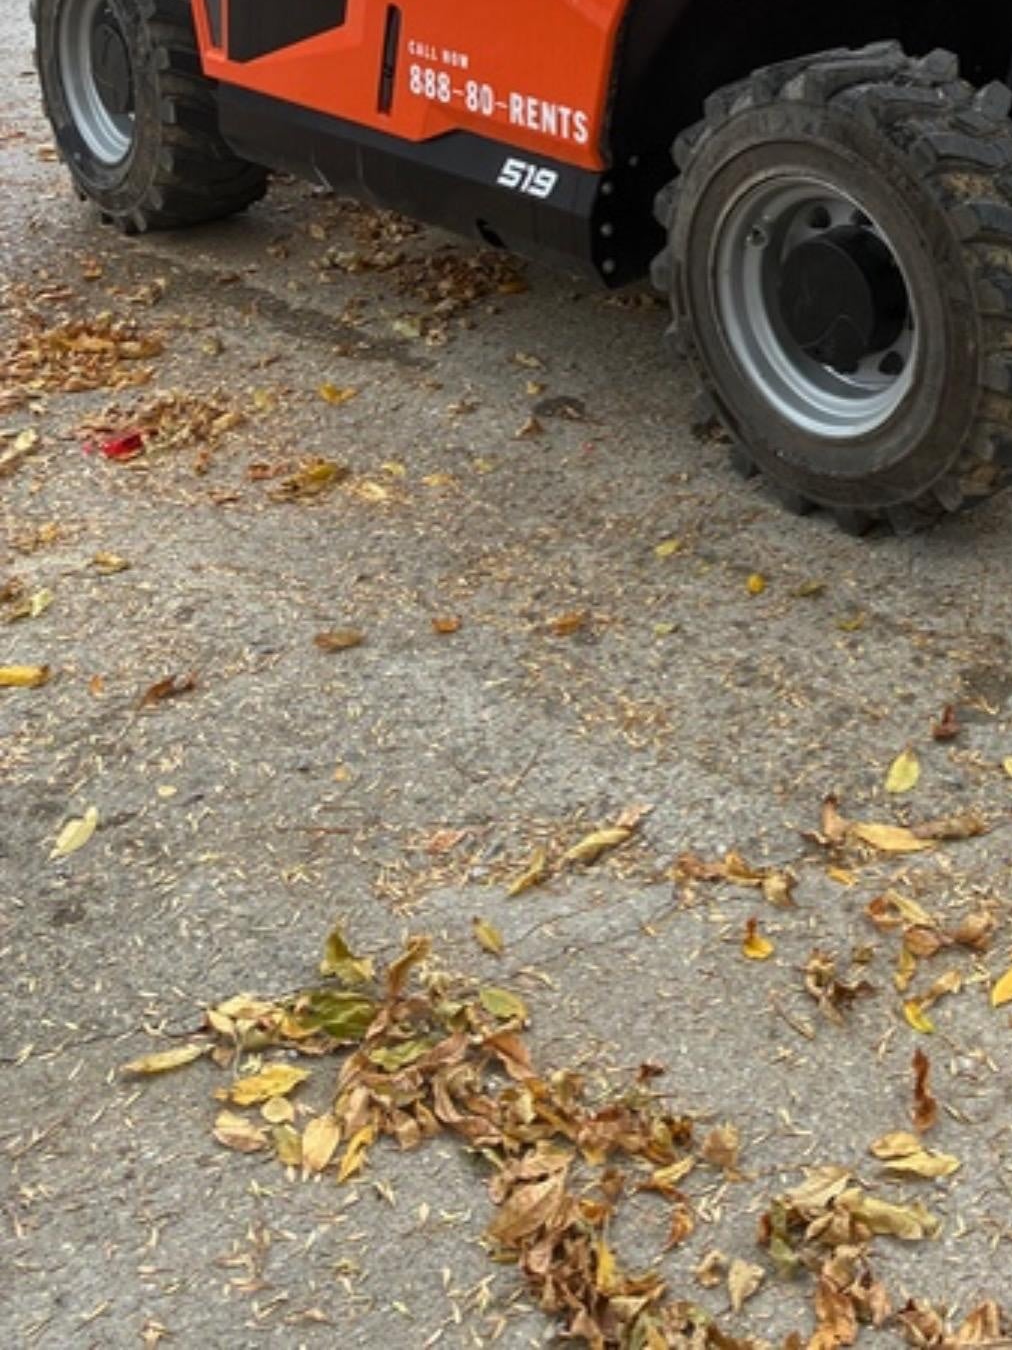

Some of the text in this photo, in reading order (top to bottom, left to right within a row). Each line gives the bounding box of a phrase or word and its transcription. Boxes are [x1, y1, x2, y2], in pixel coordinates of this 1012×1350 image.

[407, 39, 468, 69] CALL NOW
[409, 63, 590, 144] 888-80-RENTS
